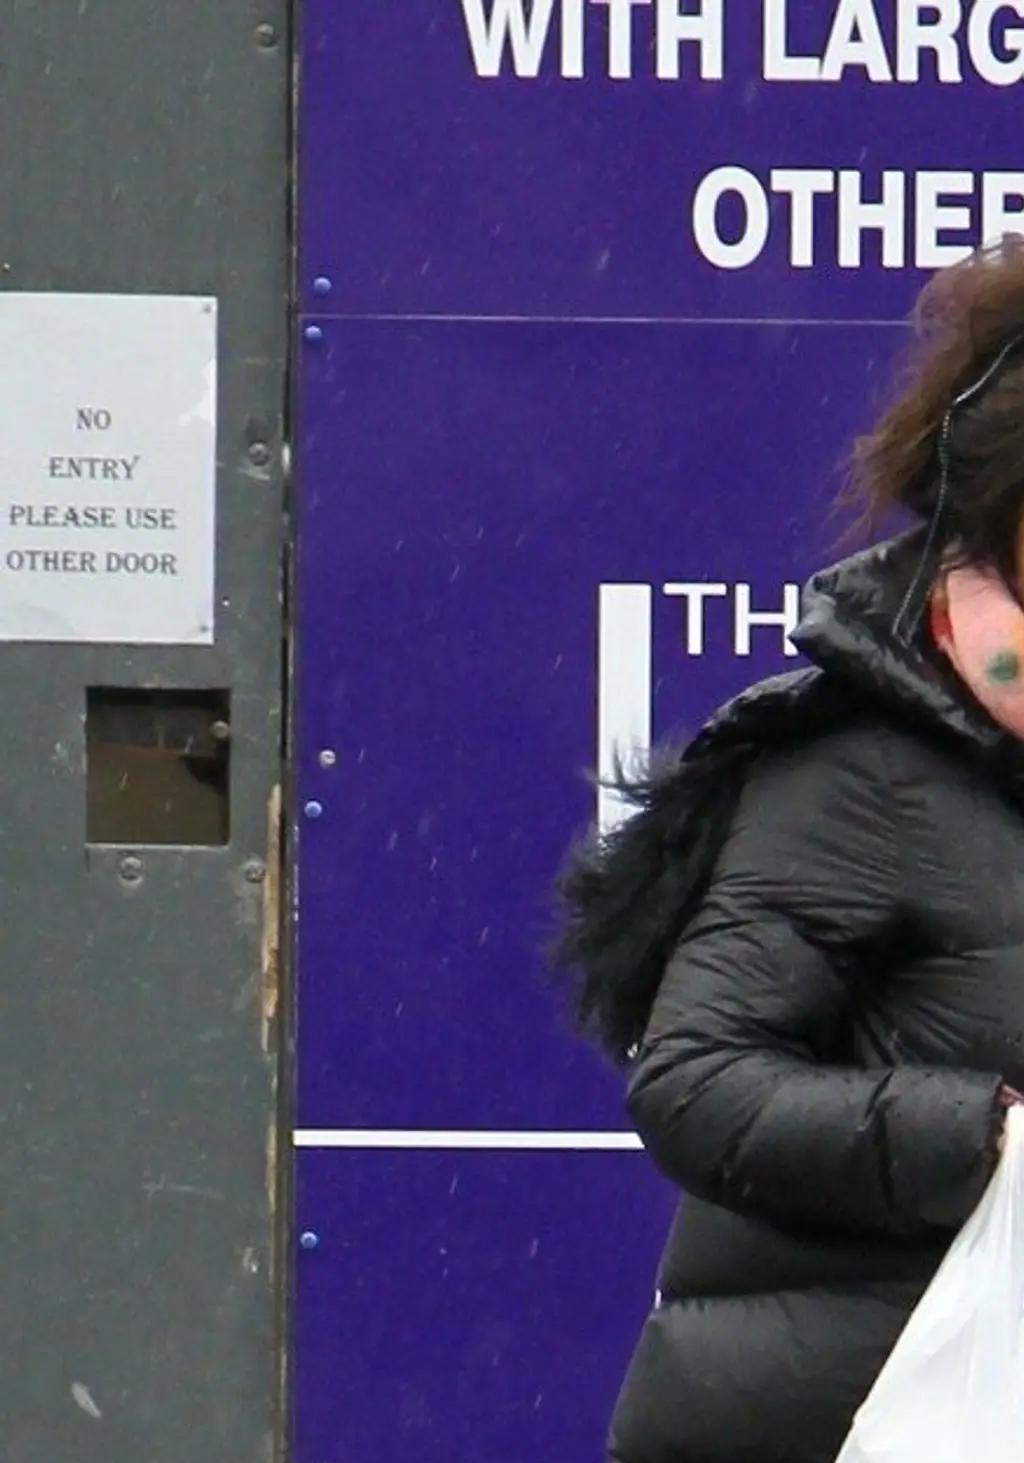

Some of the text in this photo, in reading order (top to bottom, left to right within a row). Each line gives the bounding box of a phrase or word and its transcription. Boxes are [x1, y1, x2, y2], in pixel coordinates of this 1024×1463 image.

[461, 0, 724, 80] WITH
[76, 408, 112, 430] NO
[49, 455, 140, 480] ENTRY
[9, 505, 177, 530] PLEASE USE
[6, 550, 178, 576] OTHER DOOR
